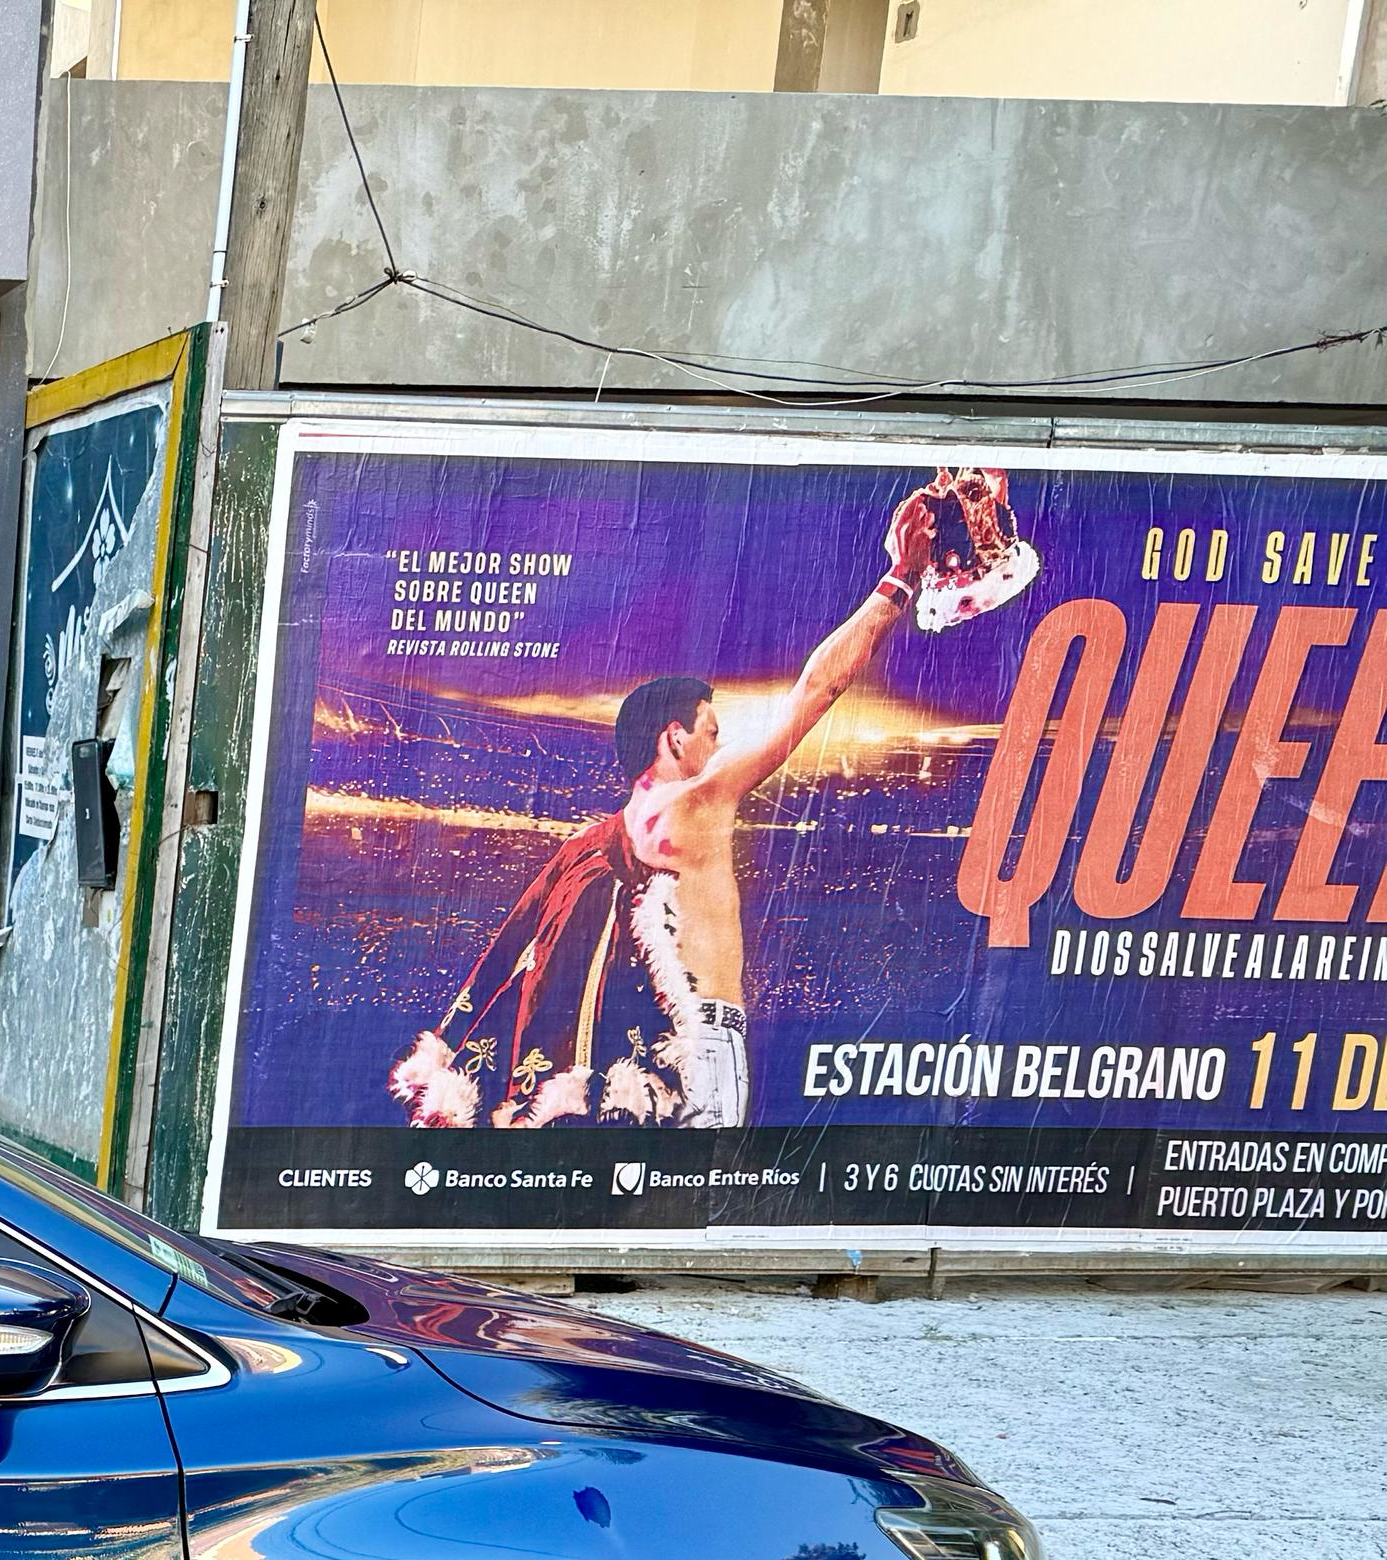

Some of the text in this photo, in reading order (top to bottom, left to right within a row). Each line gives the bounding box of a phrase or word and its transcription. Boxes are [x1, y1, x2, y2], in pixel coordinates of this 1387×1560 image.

[428, 551, 502, 574] MEJOR
[509, 553, 572, 576] SHOW
[1141, 527, 1378, 586] GOD SAVE
[394, 580, 537, 605] SOBRE QUEEN
[391, 609, 427, 631] DEL
[387, 639, 560, 659] REVISTA ROLLING STONE
[956, 598, 1387, 948] QUEE
[803, 1033, 1005, 1098] ESTACIÓN
[1011, 1044, 1227, 1101] BELGRANO
[1249, 1031, 1318, 1111] 11
[1164, 1140, 1289, 1173] ENTRADAS
[1292, 1142, 1327, 1173] EN
[278, 1169, 372, 1187] CLIENTES
[445, 1169, 593, 1188] Banco Santa Fe
[649, 1168, 800, 1187] Banco Entre Ríos
[844, 1162, 1111, 1194] 3 Y 6 CUOTAS SIN INTERÉS
[1157, 1186, 1249, 1217] PUERTO
[1251, 1188, 1325, 1218] PLAZA
[1334, 1188, 1351, 1219] Y
